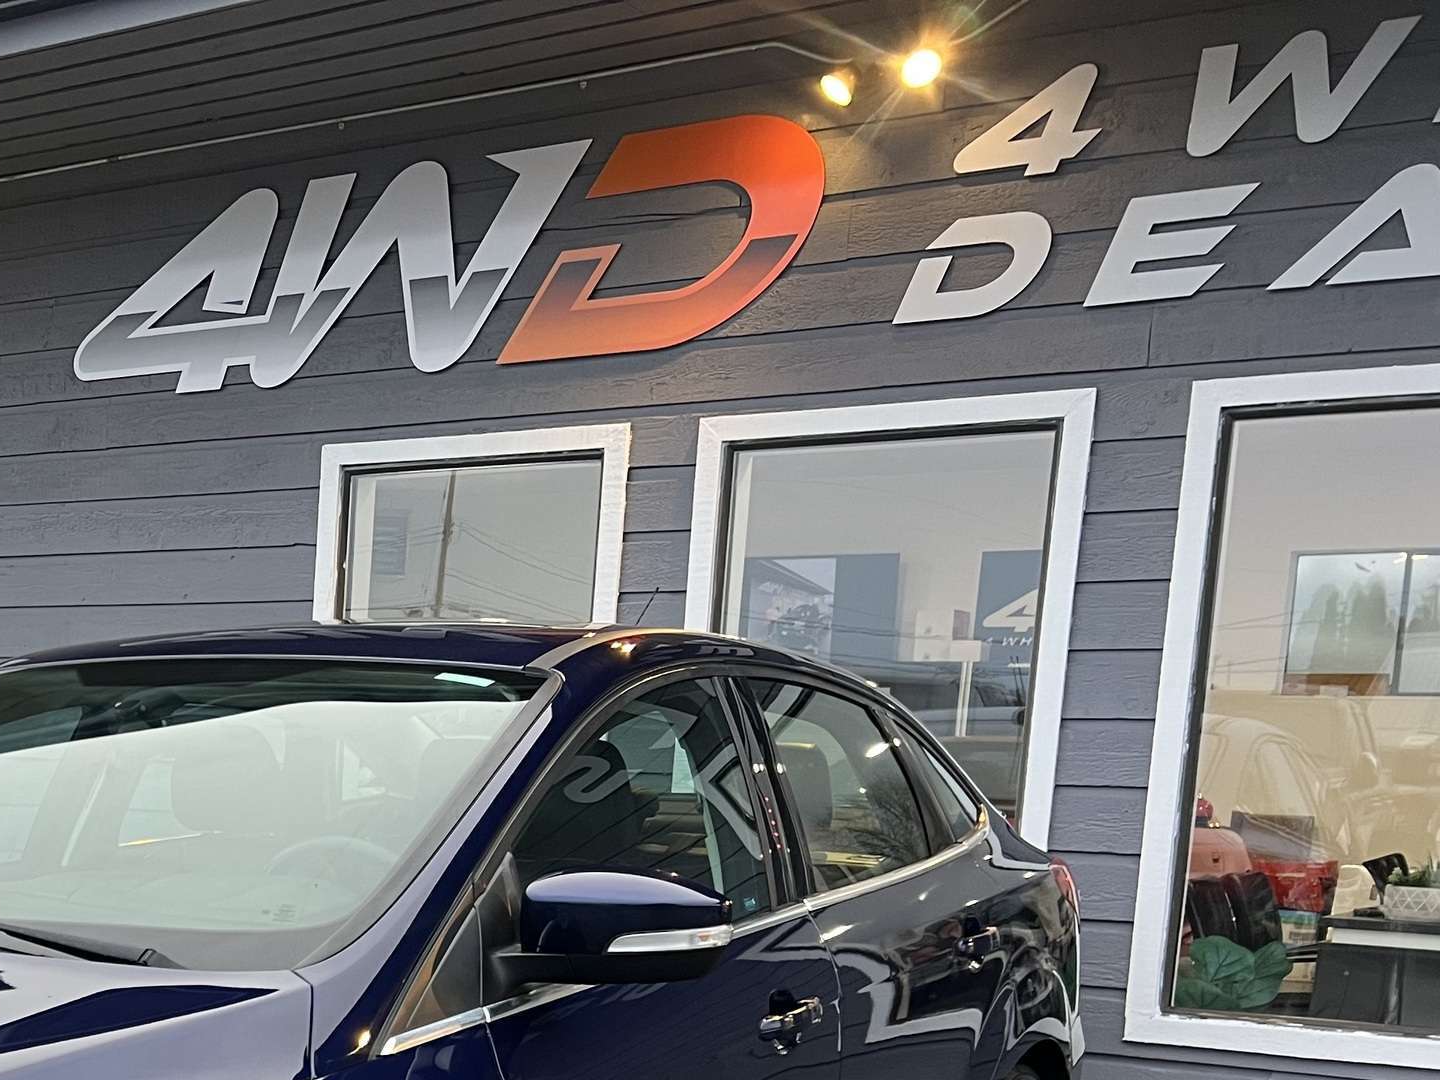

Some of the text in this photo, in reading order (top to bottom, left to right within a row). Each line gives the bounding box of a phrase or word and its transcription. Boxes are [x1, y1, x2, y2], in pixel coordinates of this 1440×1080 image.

[953, 15, 1440, 177] 4 W
[73, 114, 826, 394] 4WD
